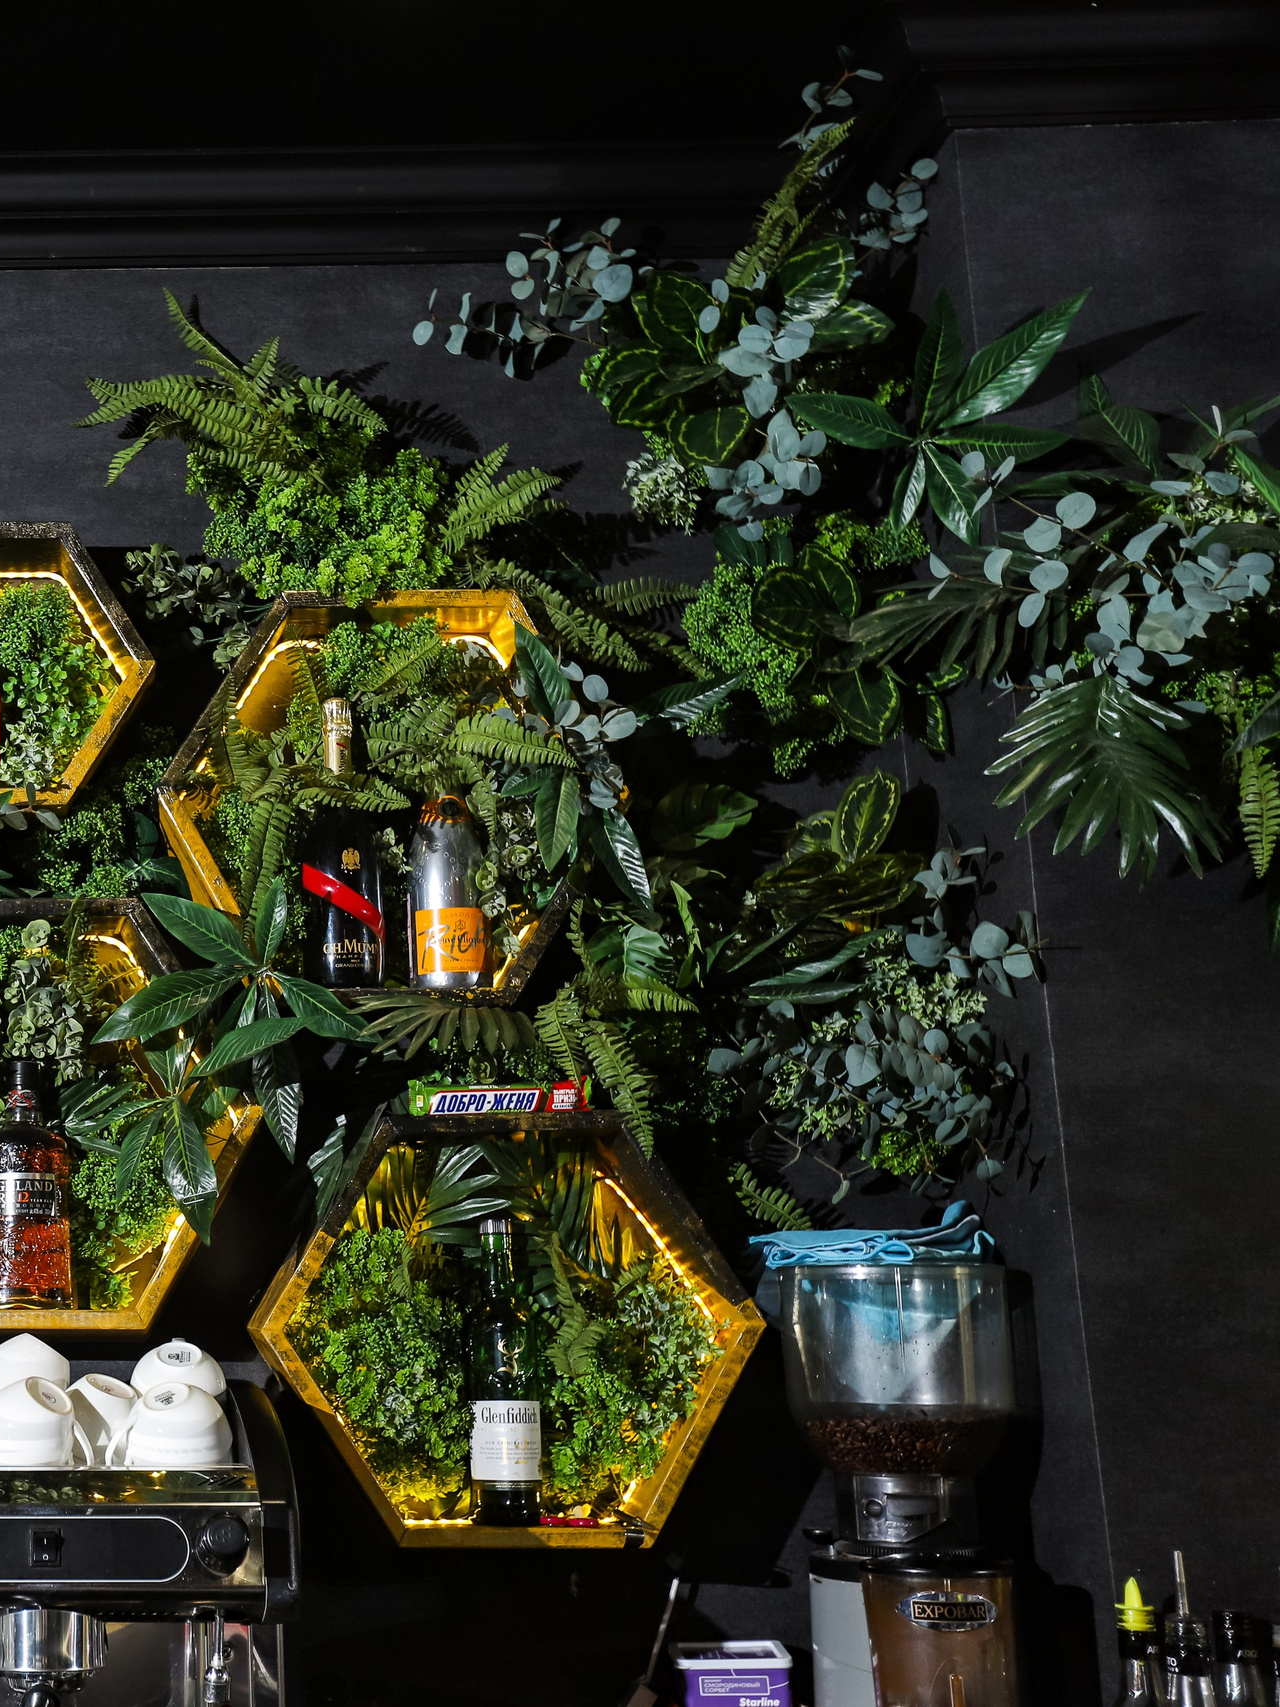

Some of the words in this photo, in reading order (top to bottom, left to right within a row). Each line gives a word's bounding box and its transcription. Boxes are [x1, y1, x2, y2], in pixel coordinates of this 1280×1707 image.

[434, 1093, 536, 1113] ДОБРО-ЖЕНЯ
[17, 1191, 30, 1203] 12
[481, 1406, 538, 1424] Glenfiddich
[913, 1603, 986, 1618] EXPOBAR
[739, 1696, 780, 1707] Starline
